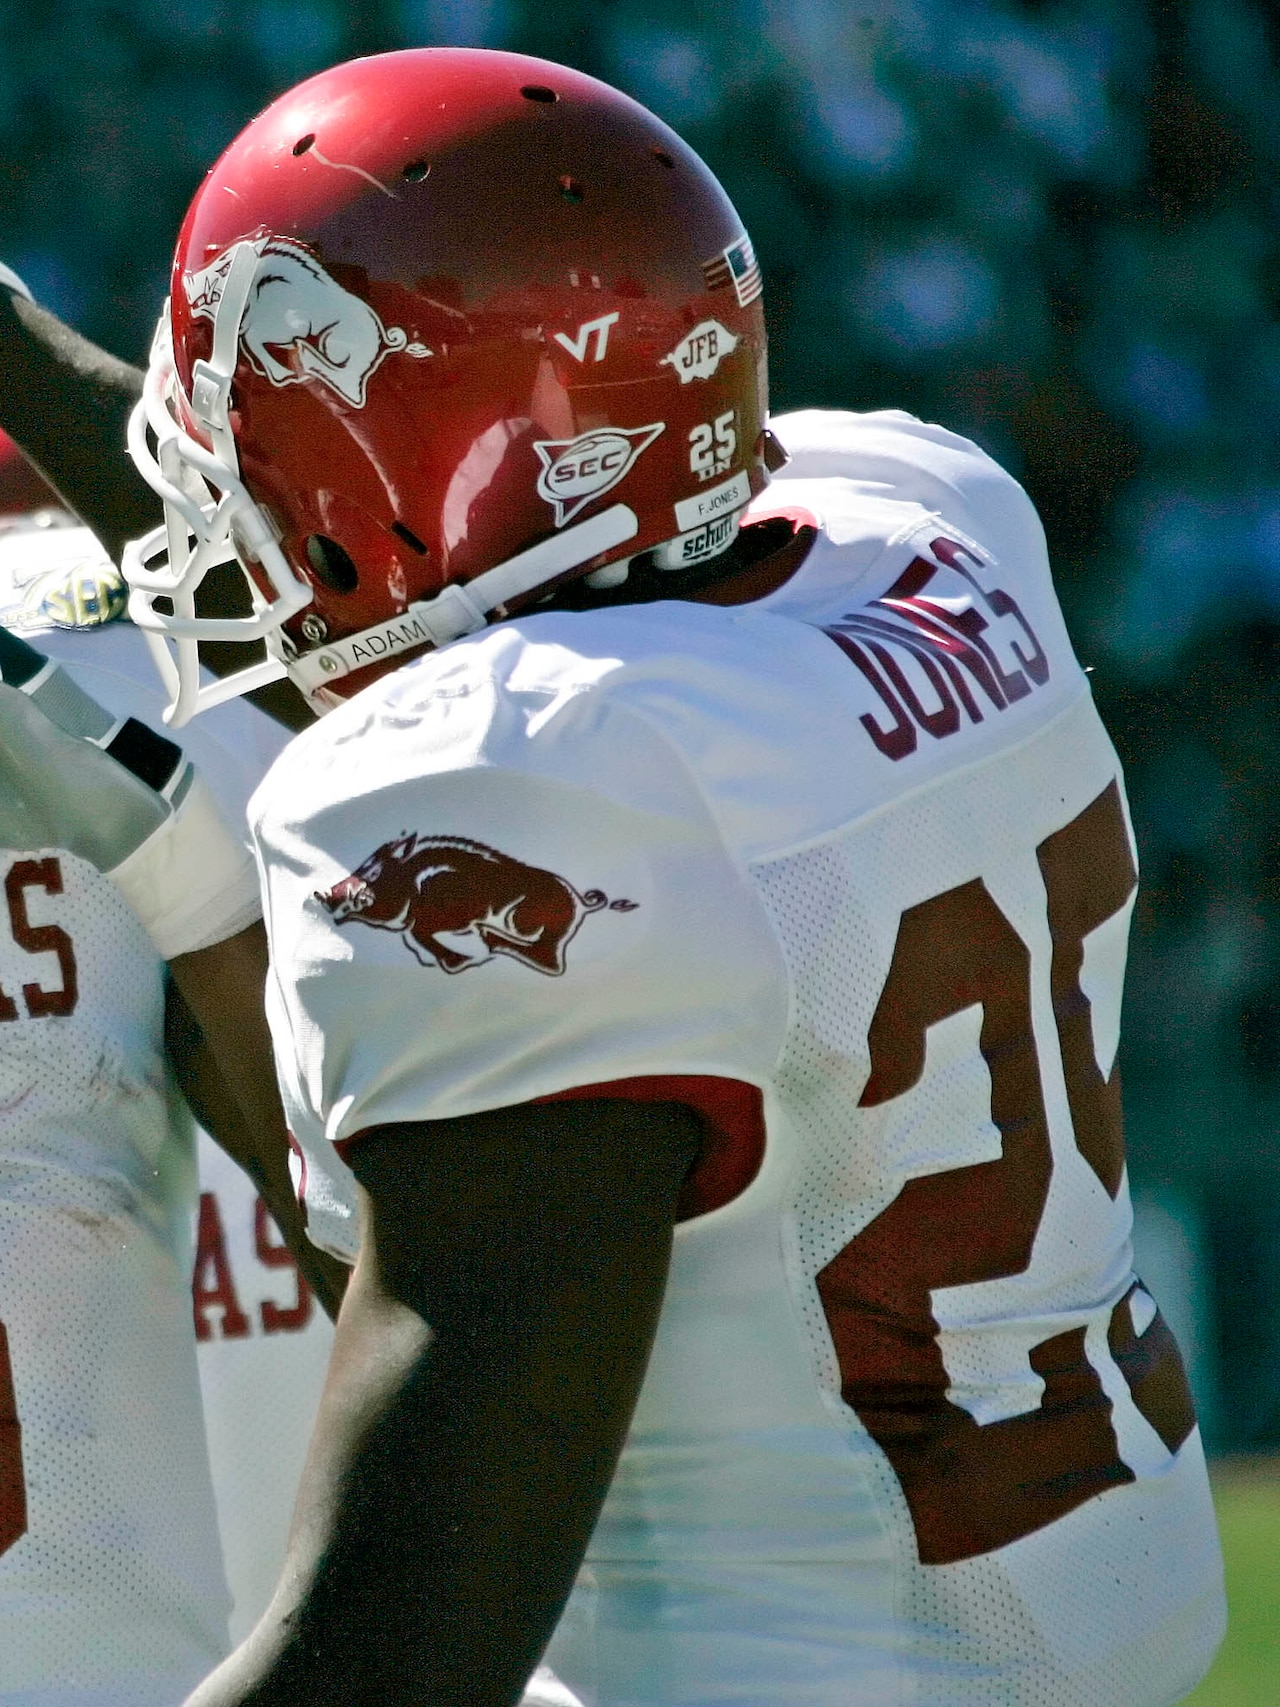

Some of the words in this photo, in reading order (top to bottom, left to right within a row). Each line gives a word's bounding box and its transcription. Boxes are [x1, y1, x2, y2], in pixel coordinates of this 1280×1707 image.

[681, 329, 719, 369] JFB
[689, 410, 736, 472] 25
[555, 451, 621, 484] SEC
[351, 619, 427, 662] ADAM
[822, 536, 1051, 762] JONES
[815, 775, 1199, 1565] 25
